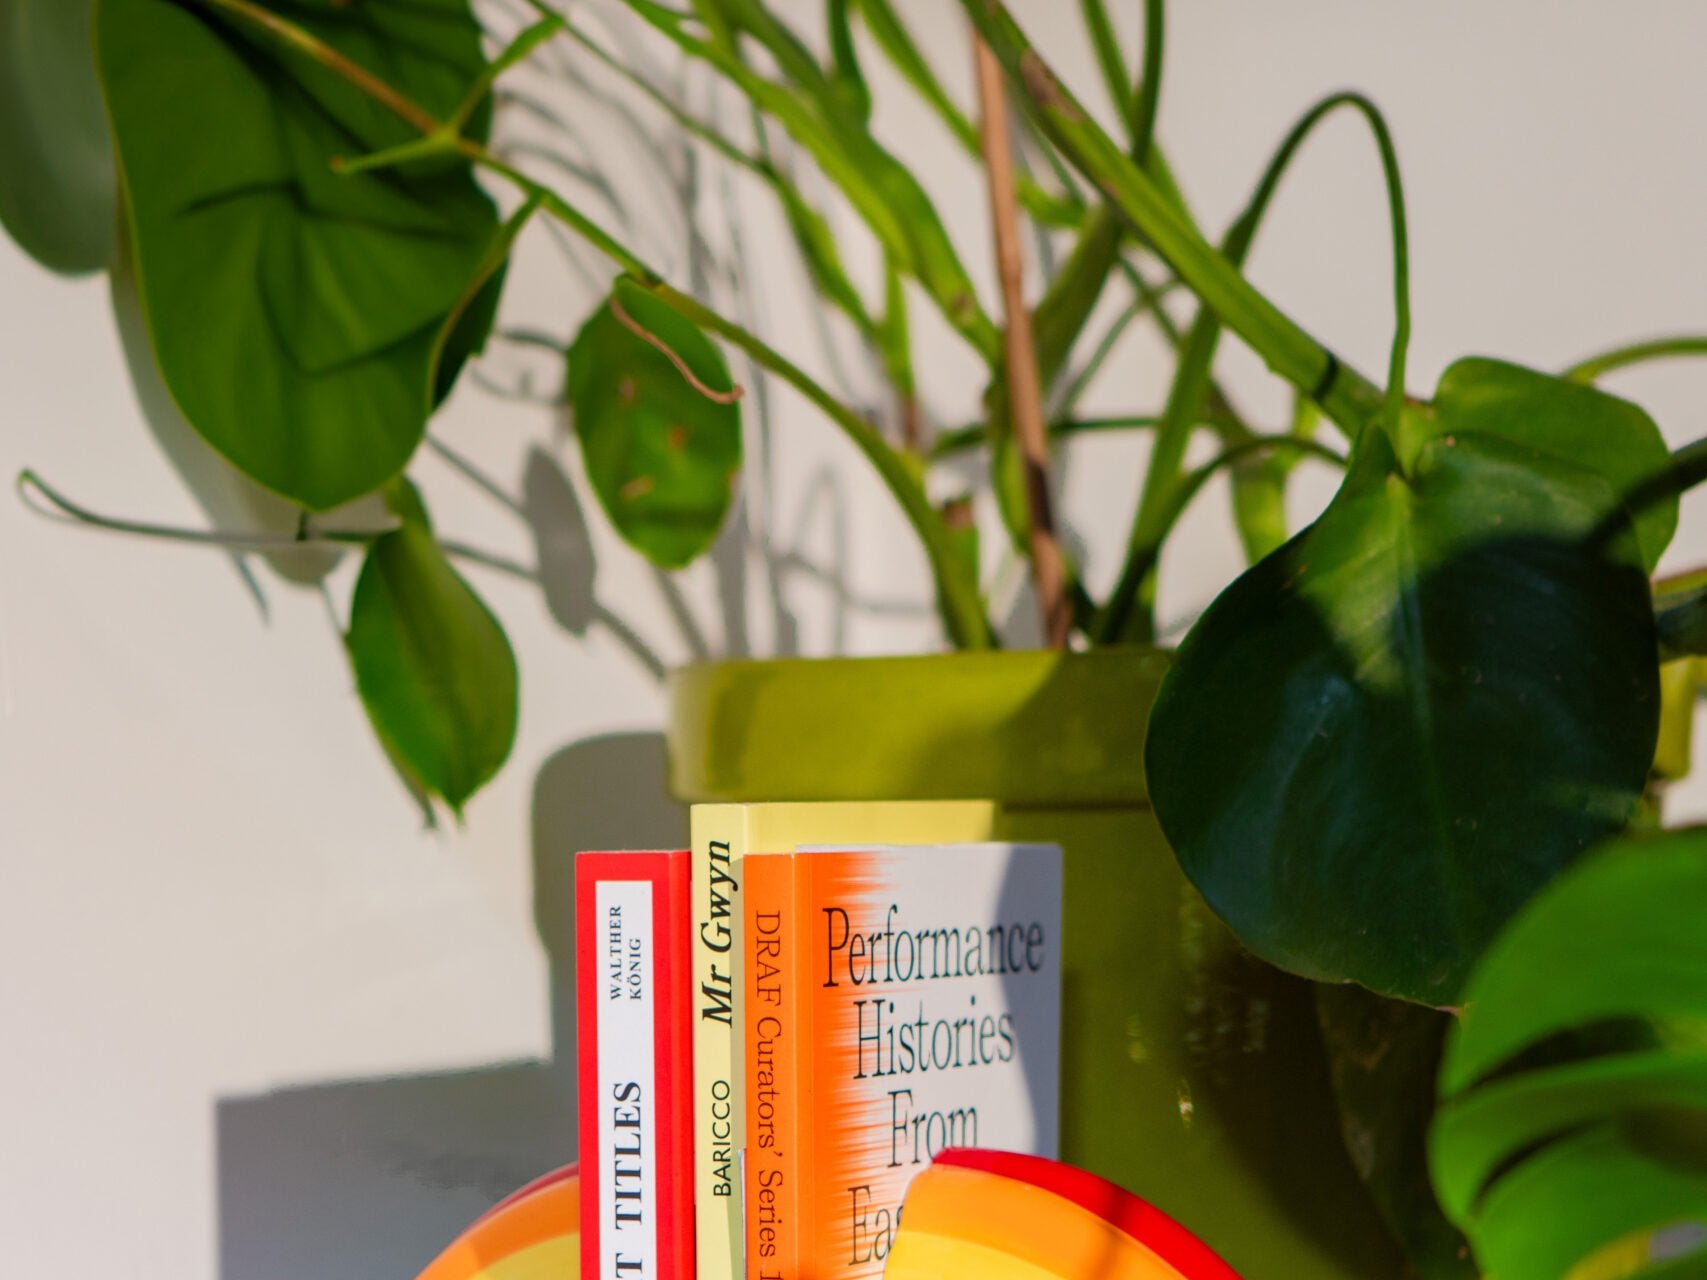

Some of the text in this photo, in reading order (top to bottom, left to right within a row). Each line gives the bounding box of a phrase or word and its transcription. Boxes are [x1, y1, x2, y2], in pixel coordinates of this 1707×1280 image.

[609, 904, 622, 1001] WALTHER
[627, 937, 642, 1001] KÖNIG
[700, 840, 738, 1029] Mr Gwyn
[756, 910, 781, 1006] DRAF
[821, 903, 1044, 988] Performance
[852, 996, 1014, 1080] Histories
[613, 1081, 642, 1230] TITLES
[712, 1080, 731, 1196] BARICCO
[887, 1089, 978, 1168] From
[758, 1170, 784, 1258] Series
[848, 1185, 904, 1266] Ea
